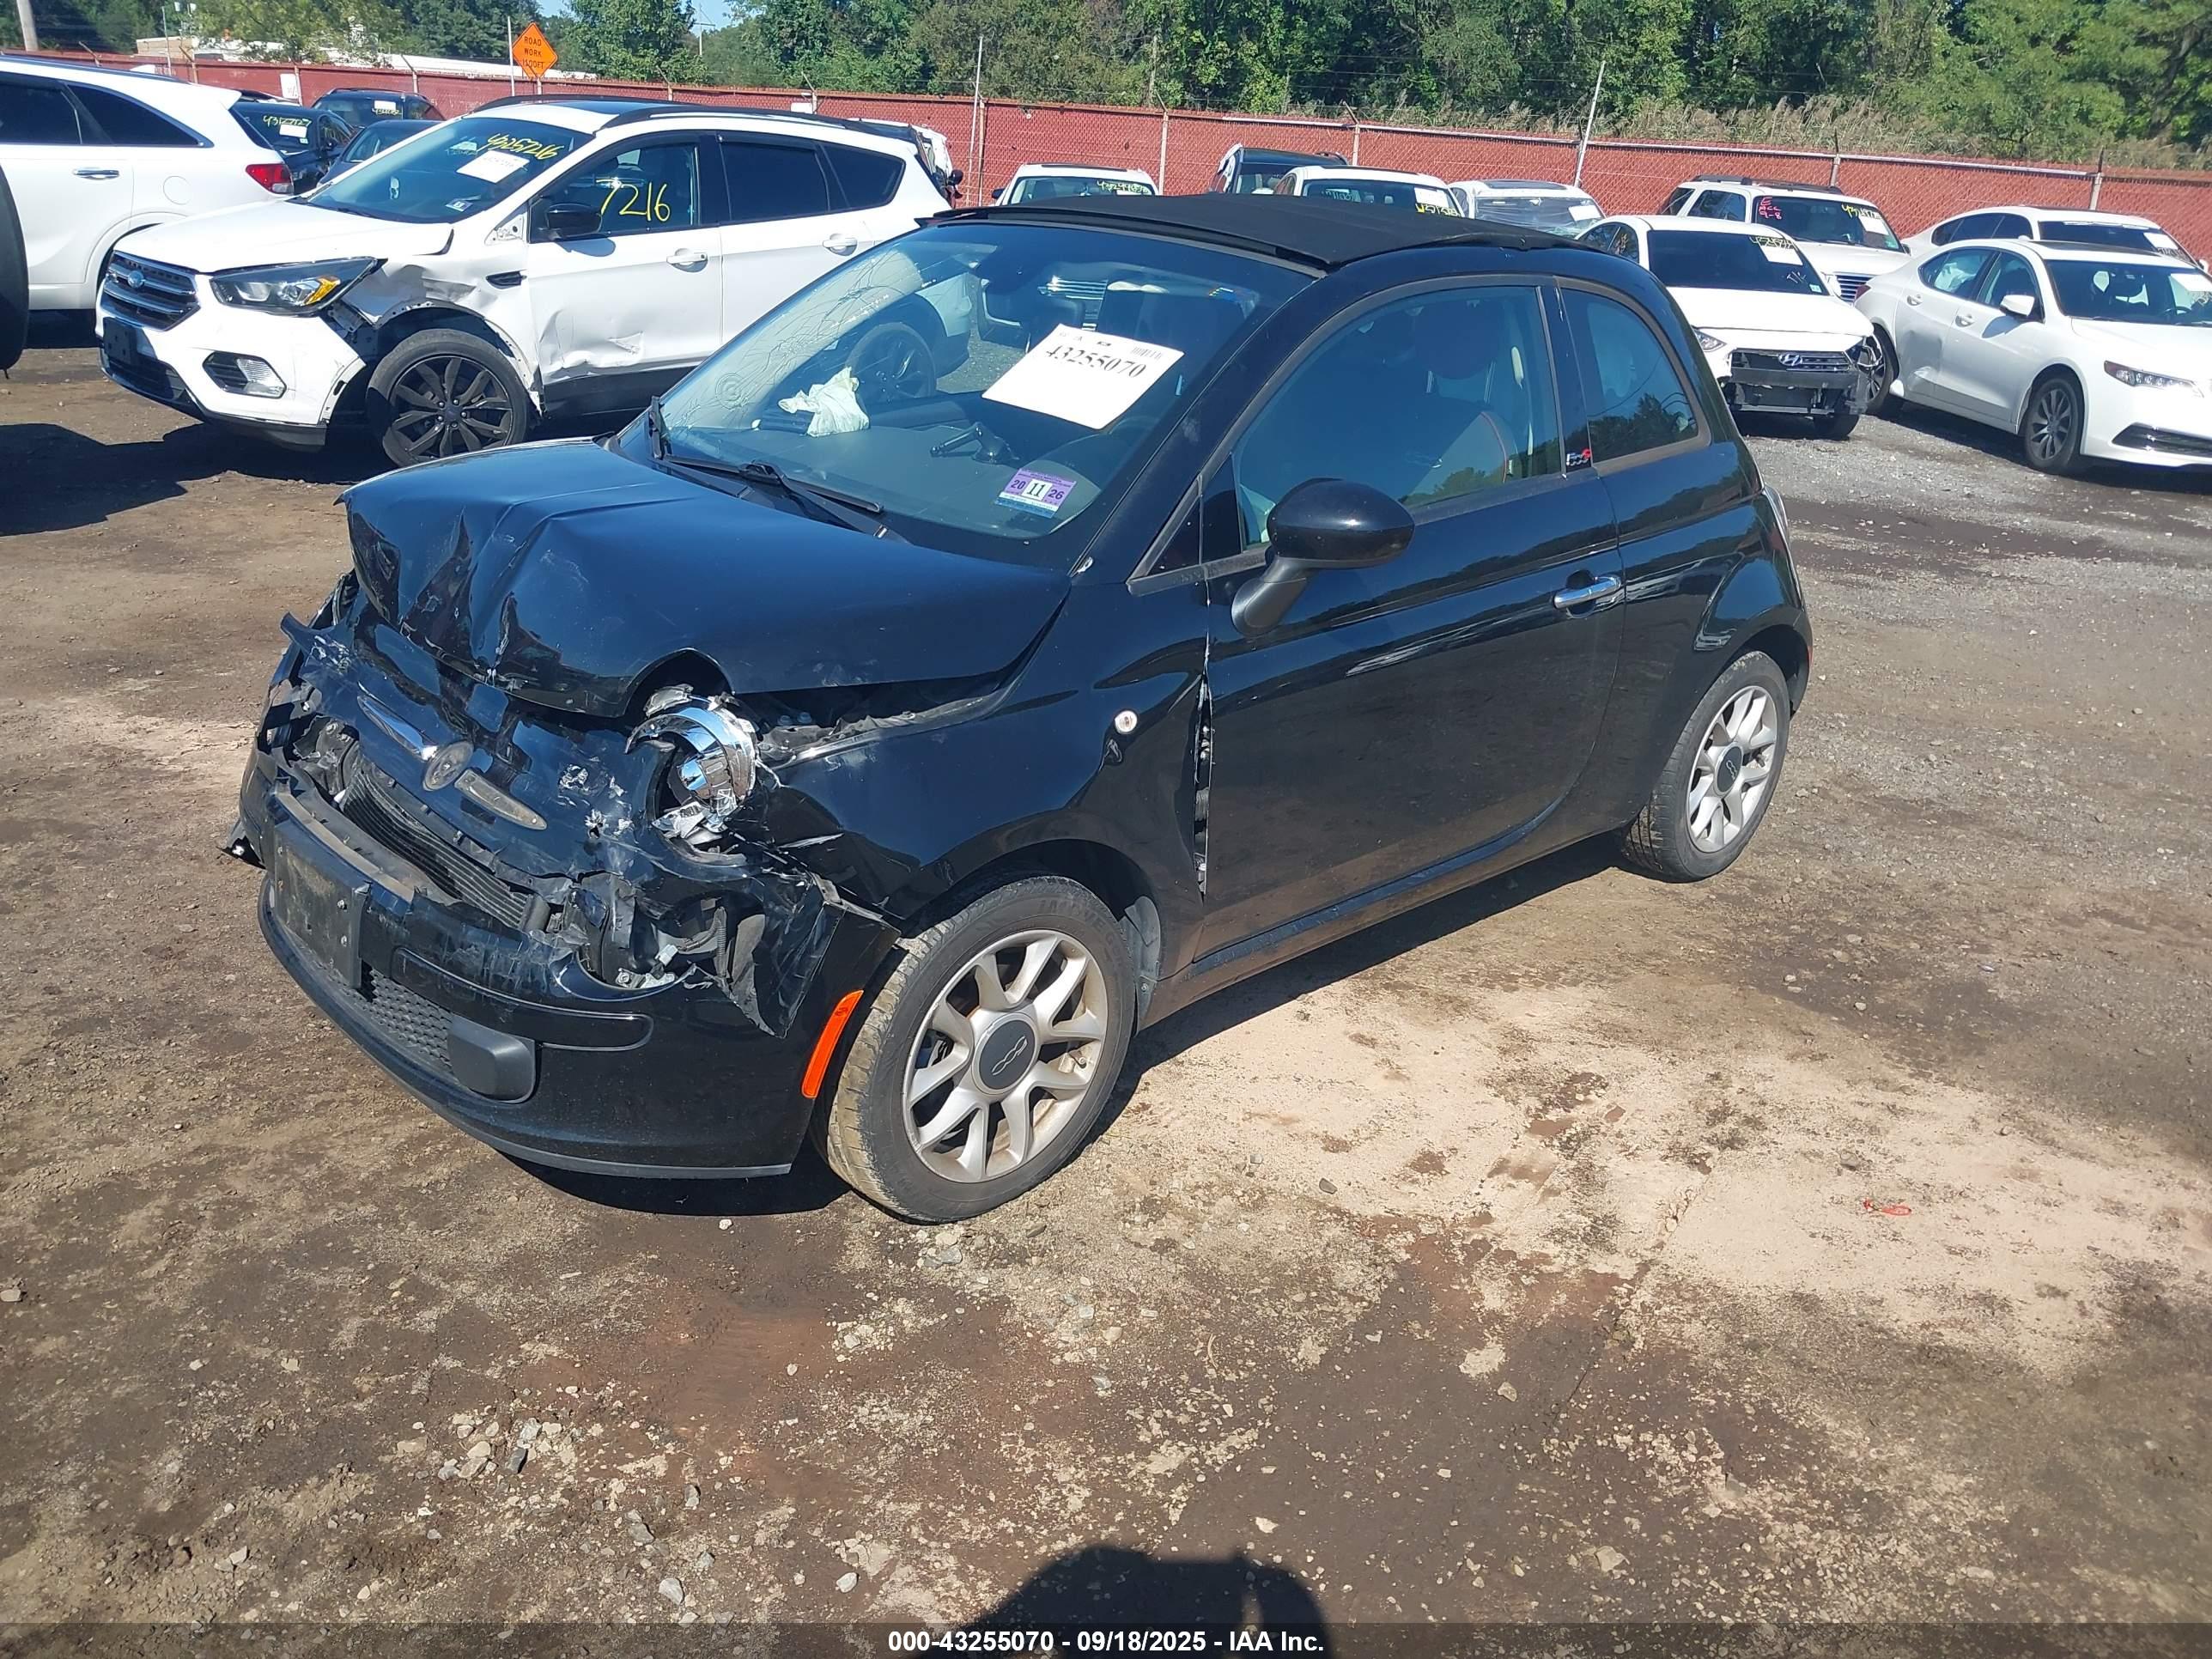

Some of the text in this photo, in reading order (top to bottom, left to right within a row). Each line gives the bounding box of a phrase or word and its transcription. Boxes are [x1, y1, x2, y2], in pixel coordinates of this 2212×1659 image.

[524, 36, 542, 46] ROAD
[524, 48, 542, 58] WORK
[595, 178, 671, 222] 7216
[1045, 344, 1147, 378] 43255070
[1010, 479, 1065, 500] 20 11 26
